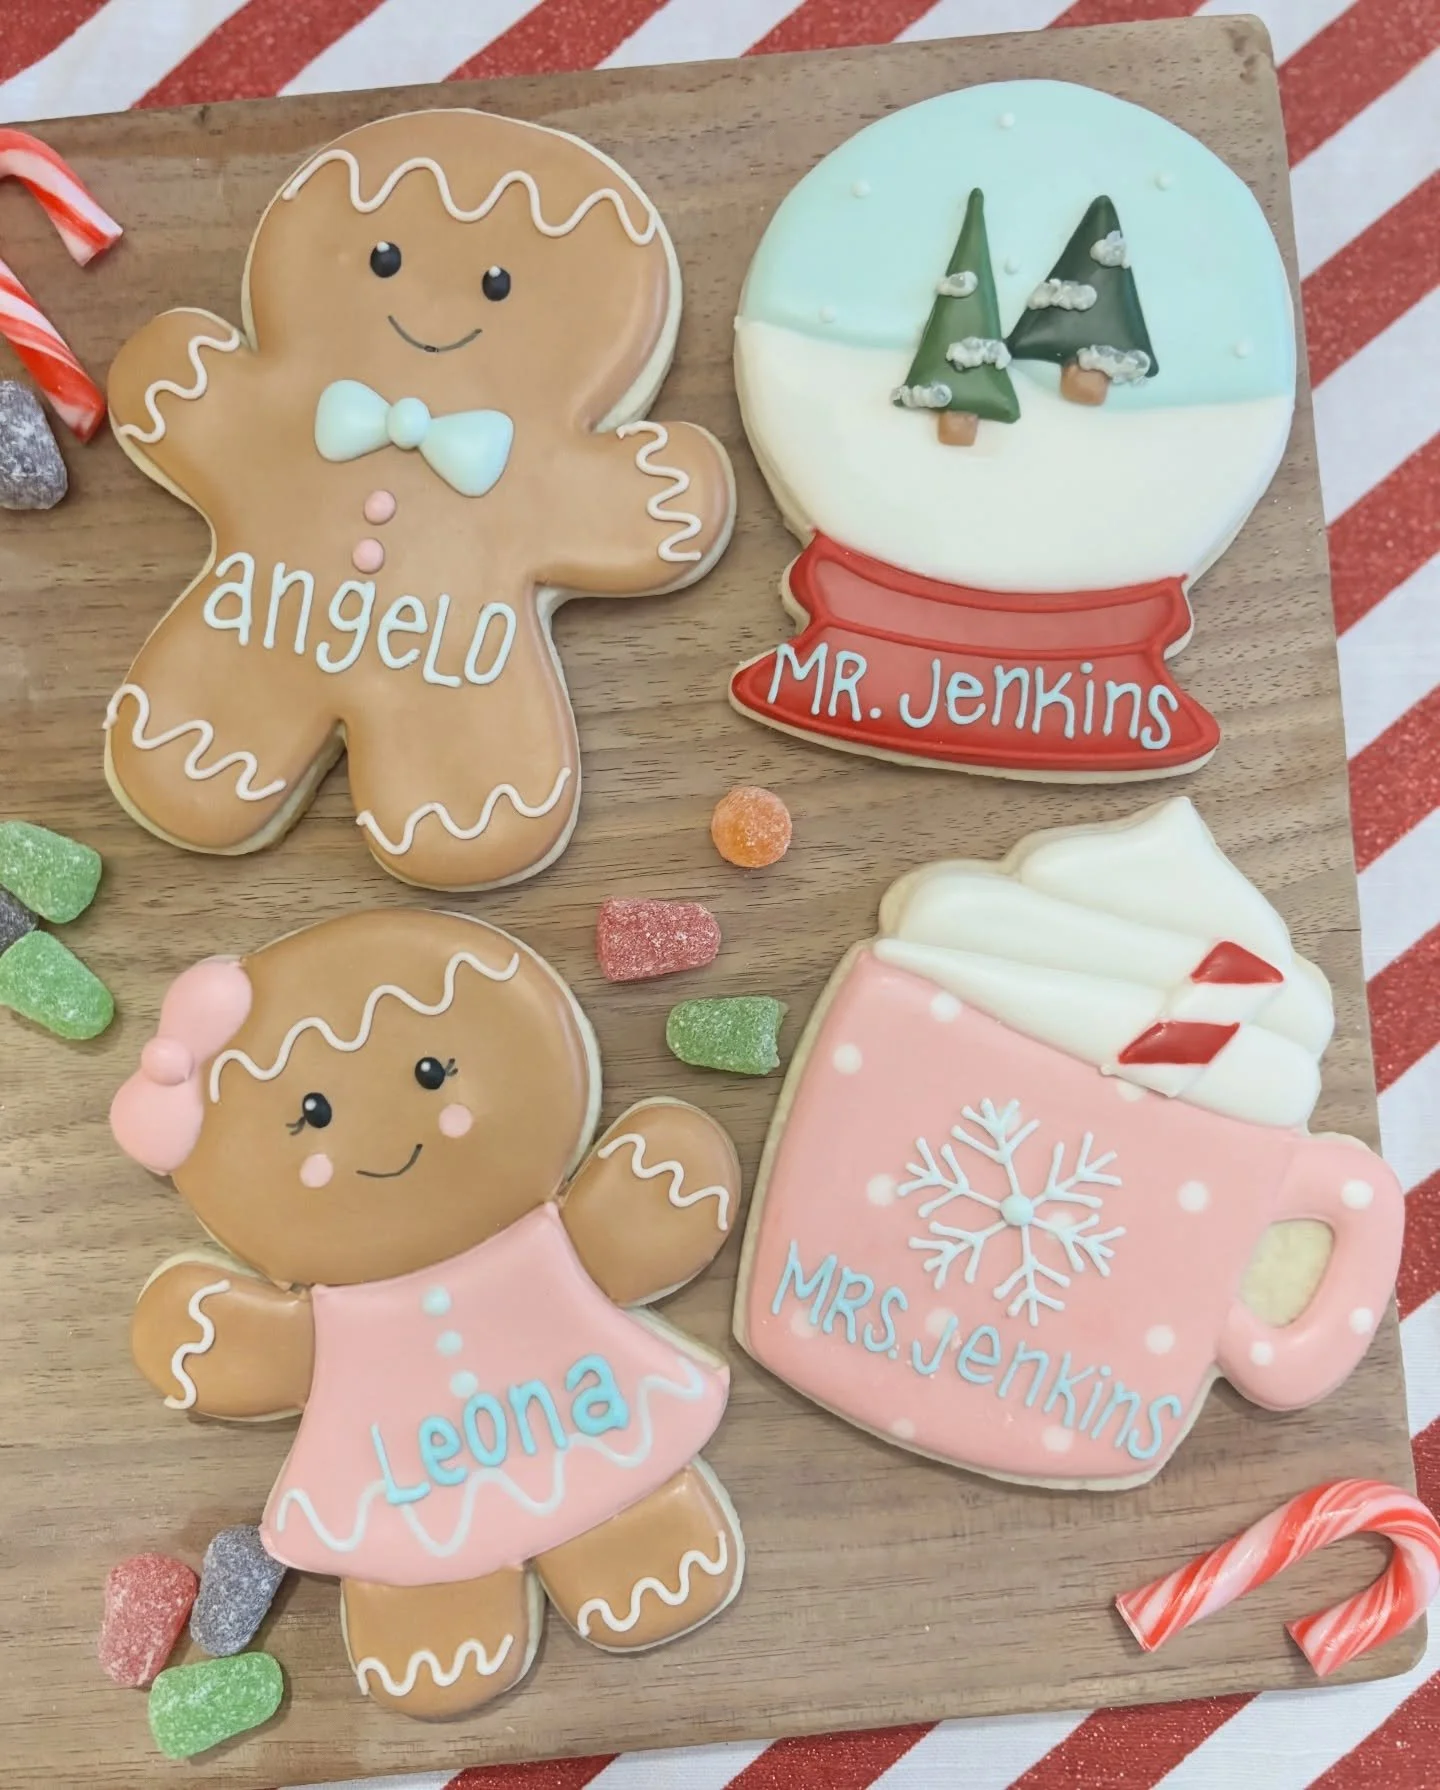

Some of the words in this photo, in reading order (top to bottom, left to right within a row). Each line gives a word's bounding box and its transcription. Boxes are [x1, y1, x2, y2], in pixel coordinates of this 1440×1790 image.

[767, 643, 882, 722] MR.
[900, 658, 1178, 750] Jenkins
[371, 1352, 630, 1506] Leona
[911, 1316, 1182, 1460] Jenkins
